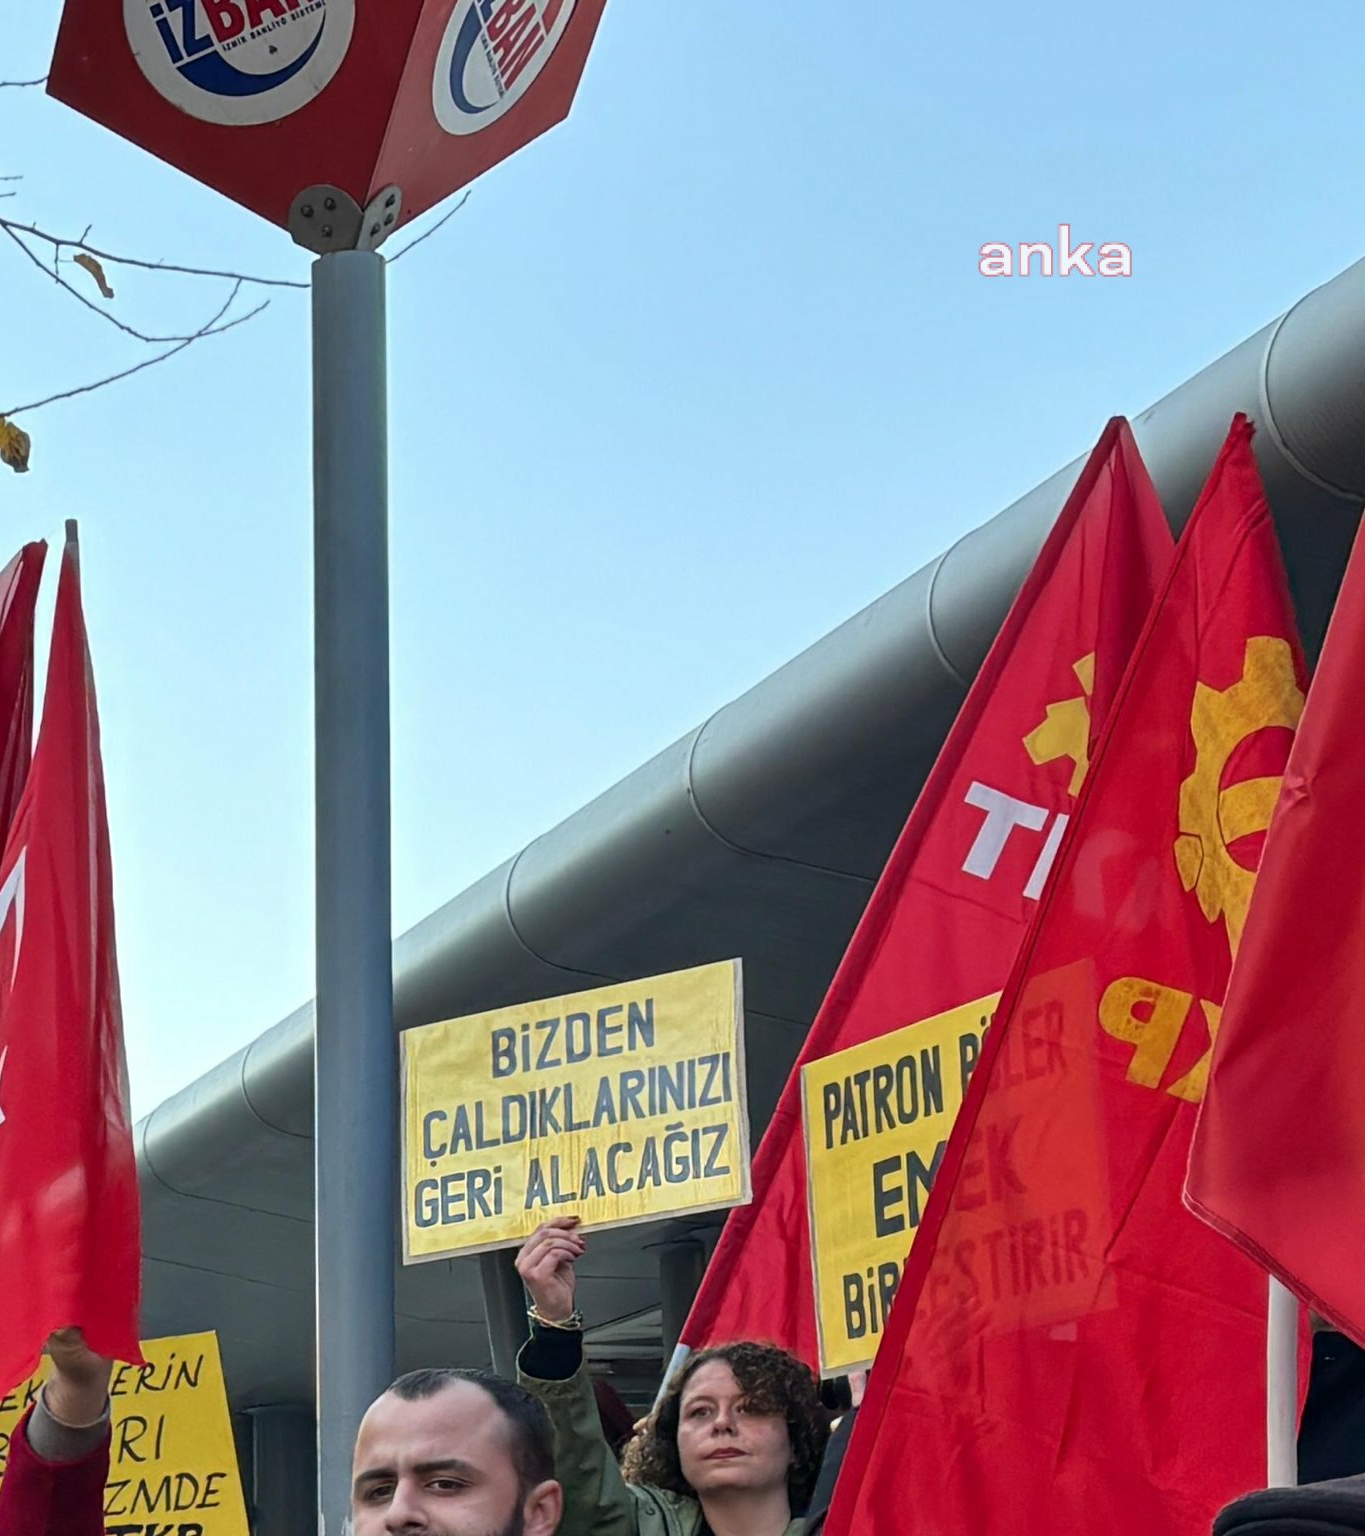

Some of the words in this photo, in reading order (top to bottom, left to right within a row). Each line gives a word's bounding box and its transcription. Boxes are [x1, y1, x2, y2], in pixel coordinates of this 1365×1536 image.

[423, 1052, 733, 1167] ÇALDIKLARINIZI
[823, 1045, 944, 1150] PATRON
[524, 1122, 730, 1210] ALACAĞIZ
